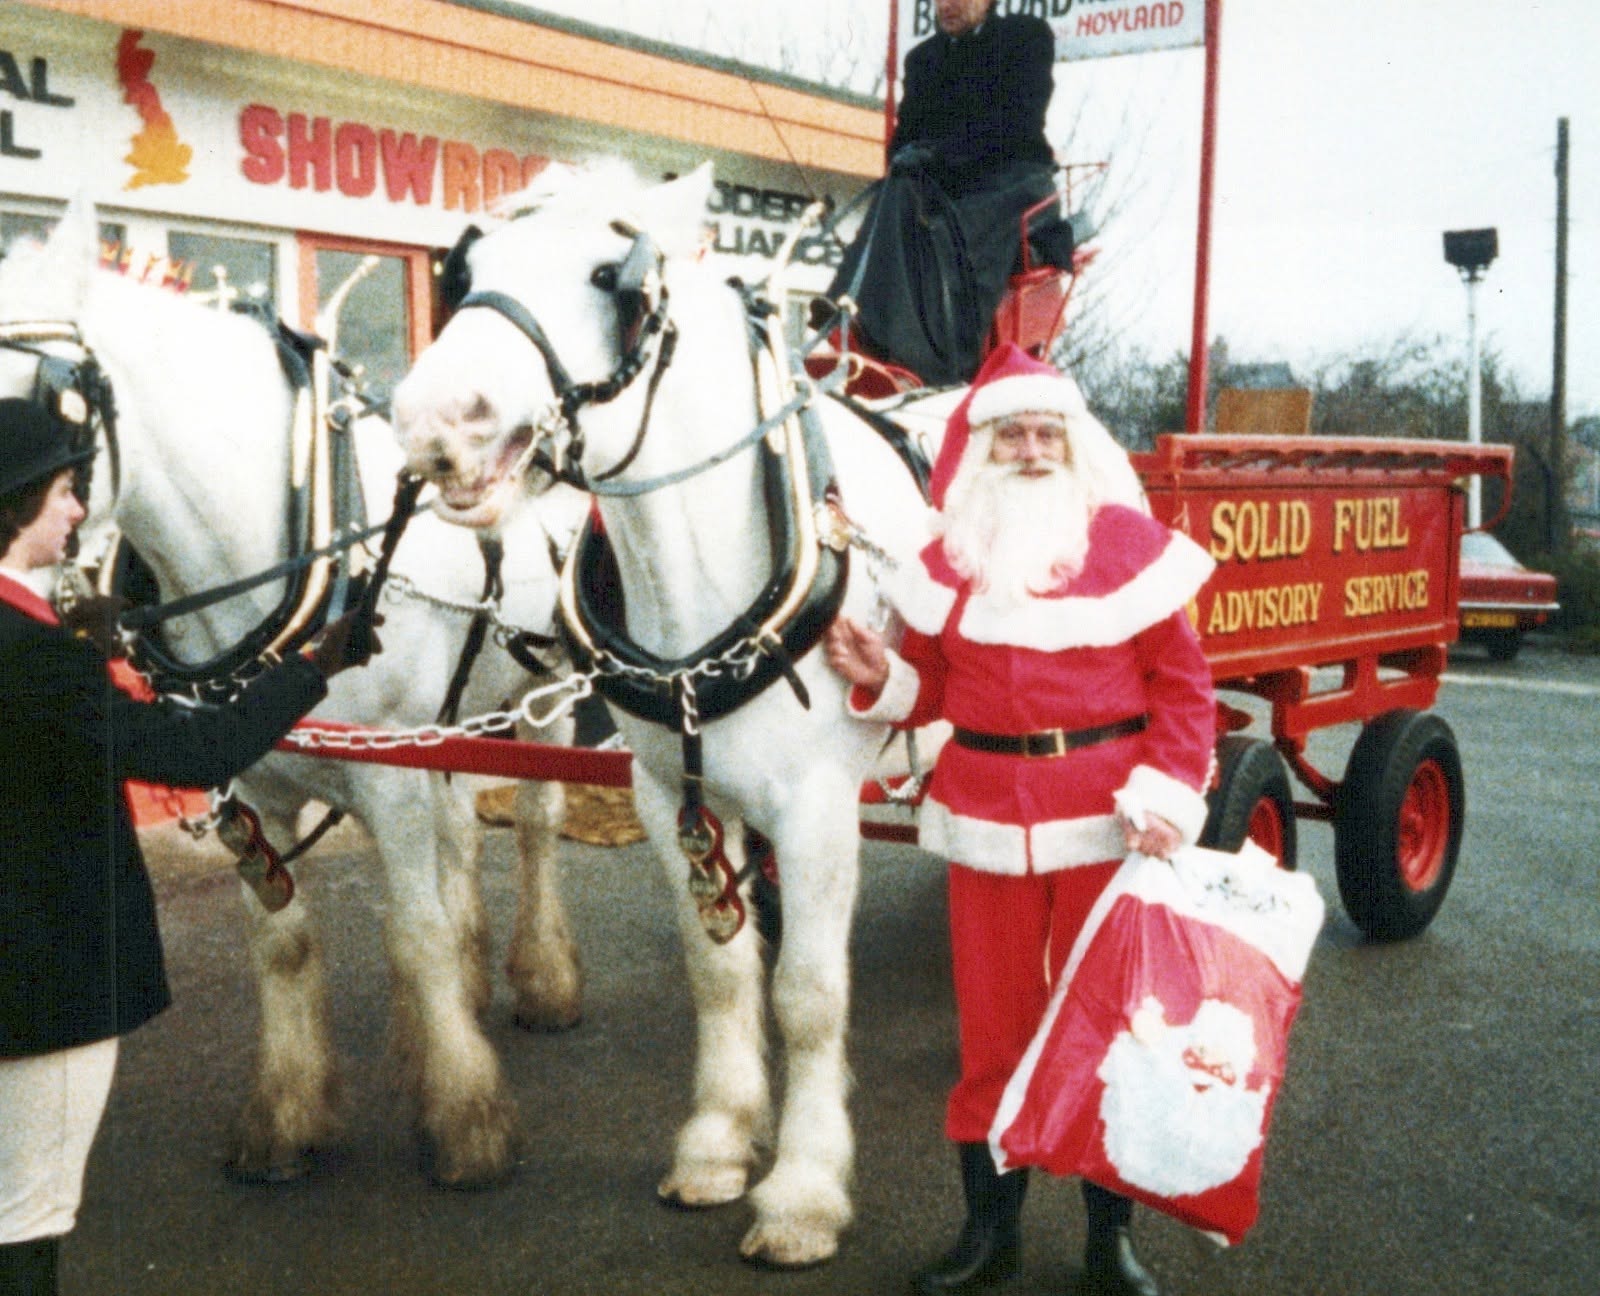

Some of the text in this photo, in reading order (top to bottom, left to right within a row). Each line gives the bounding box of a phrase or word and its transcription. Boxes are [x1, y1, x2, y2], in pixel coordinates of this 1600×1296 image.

[1076, 1, 1184, 36] HOYLAND
[239, 103, 552, 215] SHOWRO
[1210, 497, 1410, 562] SOLID FUEL
[1206, 569, 1430, 635] ADVISORY SERVICE
